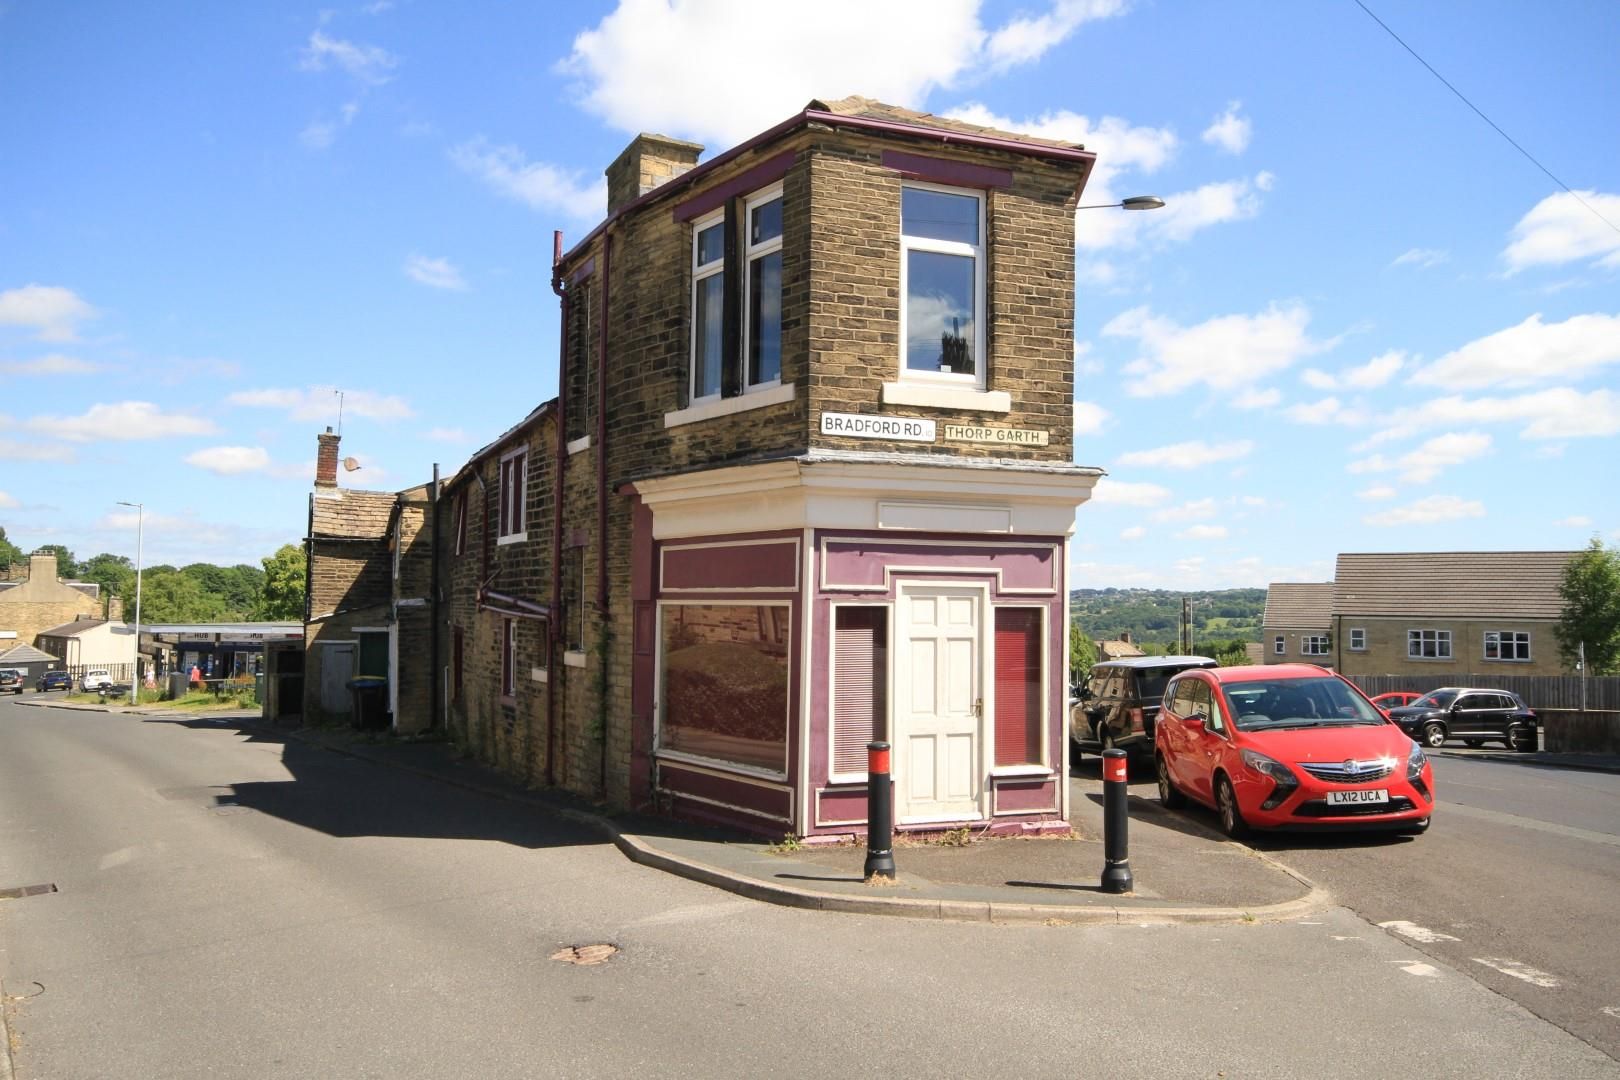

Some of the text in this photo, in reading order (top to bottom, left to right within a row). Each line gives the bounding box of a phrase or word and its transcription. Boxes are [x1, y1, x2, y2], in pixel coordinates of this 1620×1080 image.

[825, 417, 900, 434] BRADFORD
[946, 426, 1040, 442] THORP GARTH
[1333, 791, 1381, 802] LX12 UCA
